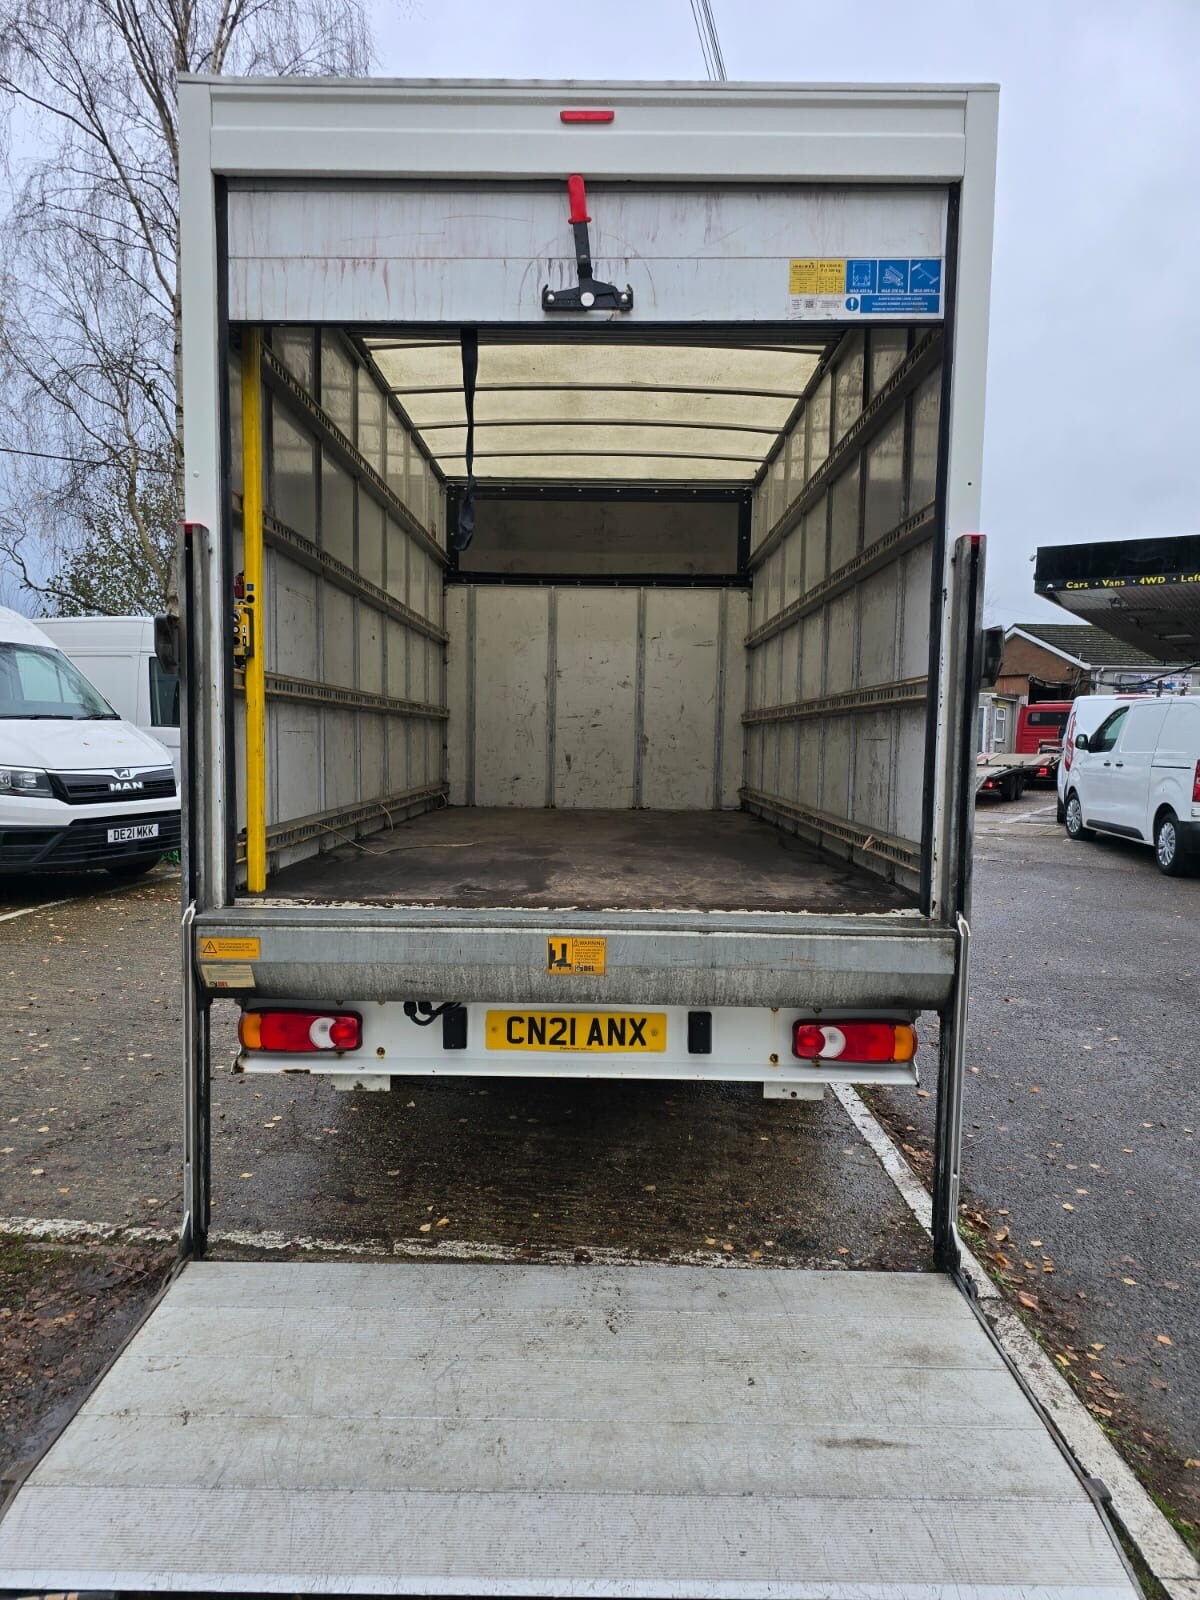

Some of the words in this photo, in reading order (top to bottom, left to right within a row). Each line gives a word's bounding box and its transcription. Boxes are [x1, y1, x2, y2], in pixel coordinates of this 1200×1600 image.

[1066, 581, 1089, 589] Cars
[1102, 579, 1126, 587] Vans
[1139, 576, 1166, 585] 4WD
[109, 781, 144, 792] MAN
[113, 827, 136, 841] DE21
[137, 825, 154, 839] MKK
[506, 1016, 576, 1046] CN21
[586, 1017, 648, 1047] ANX
